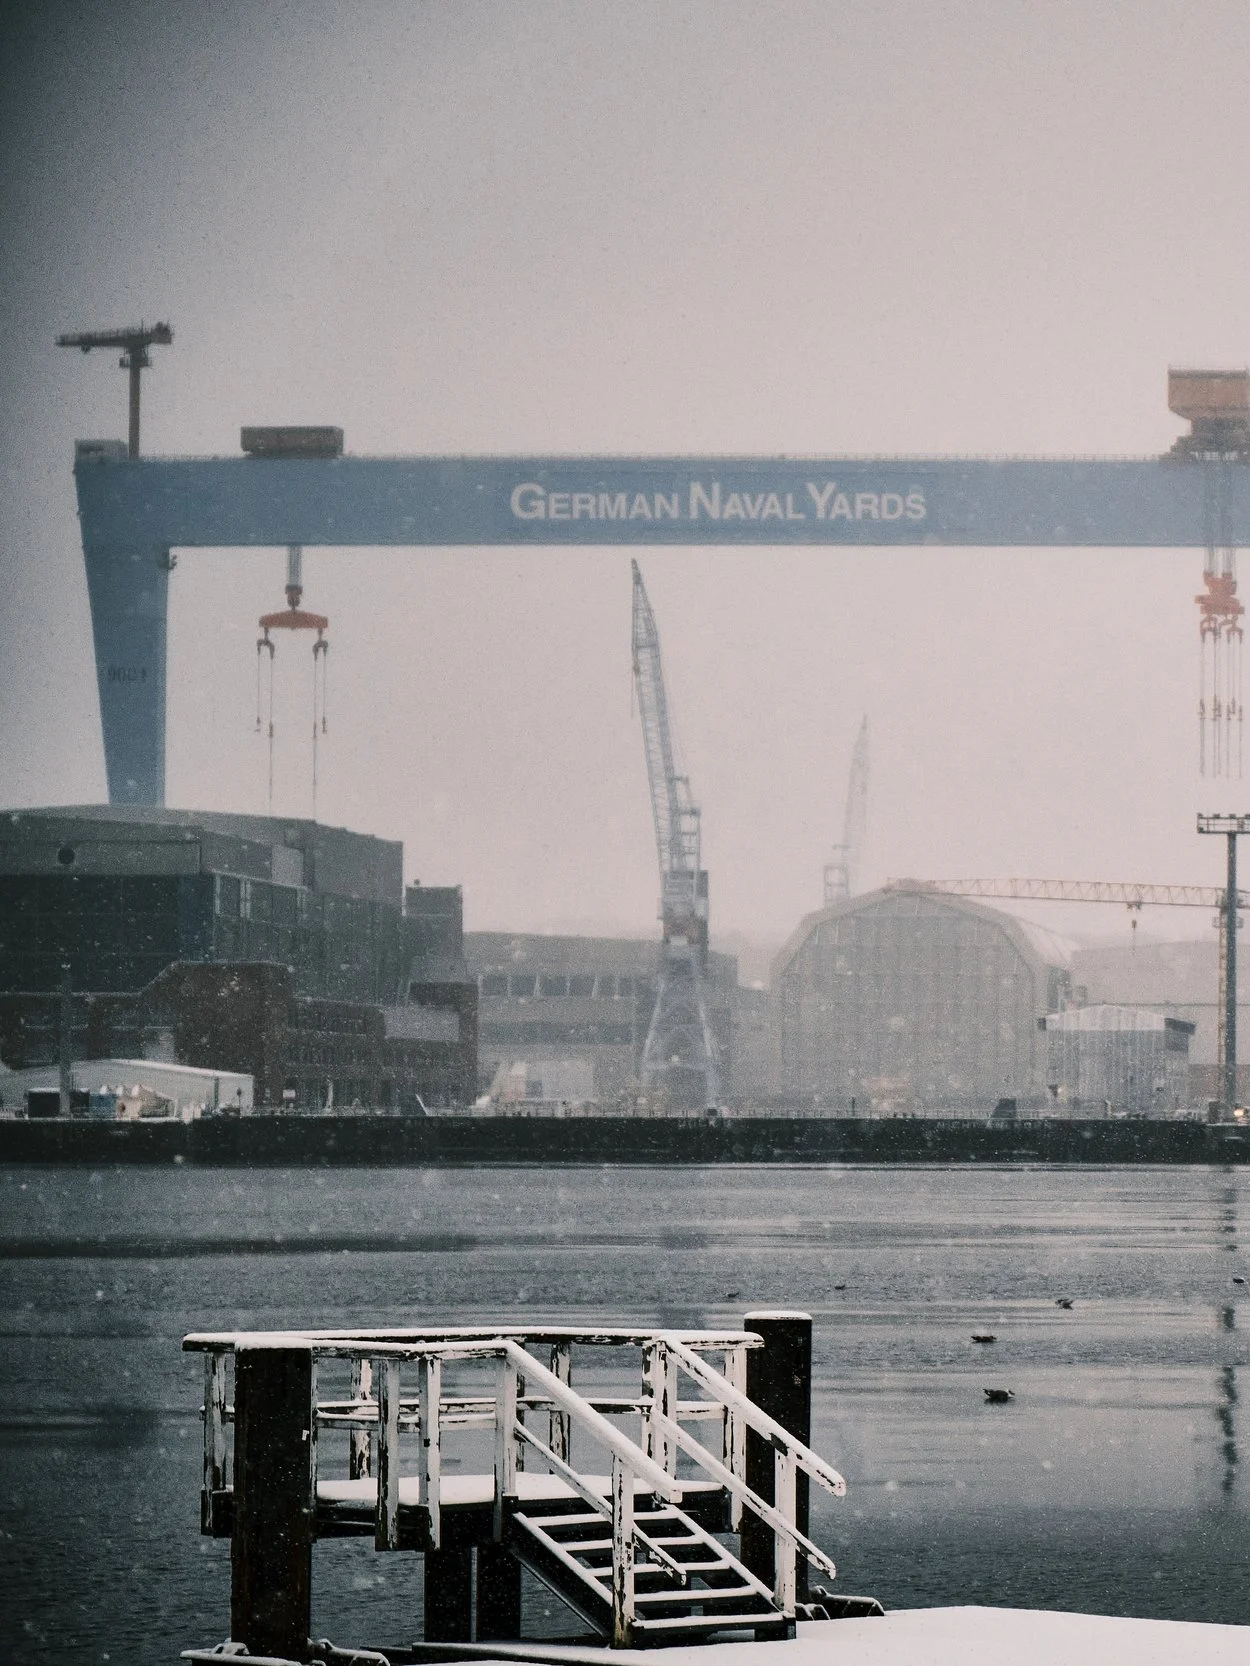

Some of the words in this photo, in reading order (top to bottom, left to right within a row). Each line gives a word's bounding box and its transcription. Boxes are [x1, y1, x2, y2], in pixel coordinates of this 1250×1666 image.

[510, 482, 680, 520] GERMAN
[689, 481, 805, 520] NAVAL
[806, 481, 928, 521] YARDS
